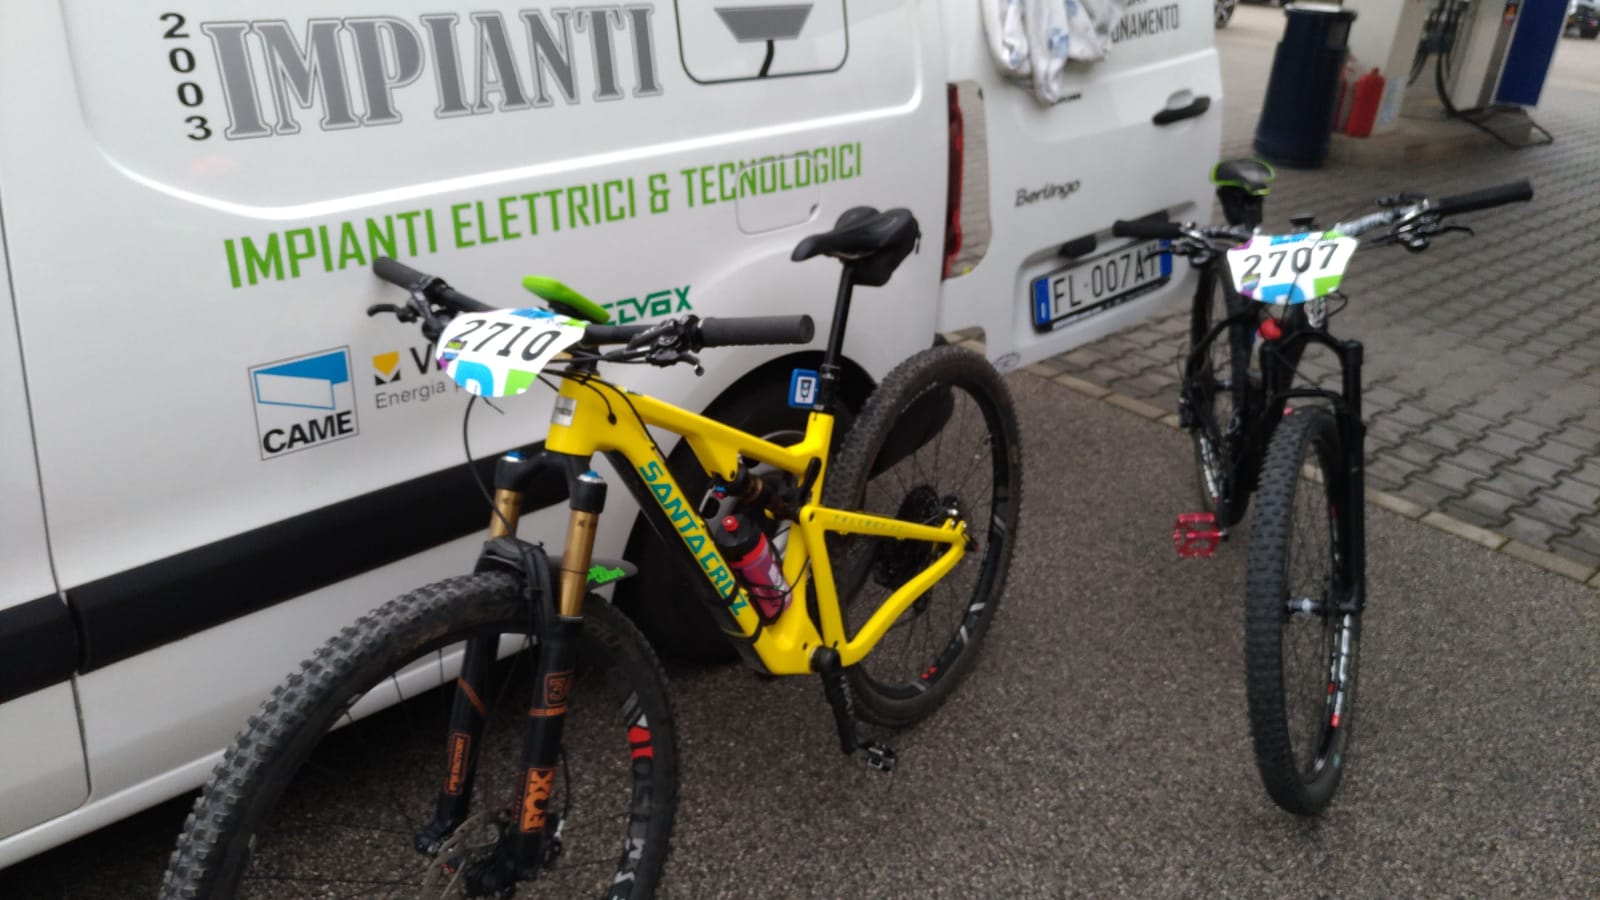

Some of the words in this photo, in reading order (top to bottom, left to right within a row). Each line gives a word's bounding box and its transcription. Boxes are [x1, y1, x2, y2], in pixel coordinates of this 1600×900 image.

[159, 12, 212, 141] 2003
[200, 3, 664, 141] IMPIANTI
[223, 208, 437, 289] IMPIANTI
[450, 176, 636, 250] ELETTRICI
[649, 173, 671, 214] &
[681, 141, 862, 208] TECNOLOGICI
[1241, 243, 1340, 285] 2707
[444, 319, 562, 362] 2710
[375, 380, 446, 410] Energia
[262, 409, 354, 455] CAME
[639, 460, 706, 556] SANTA
